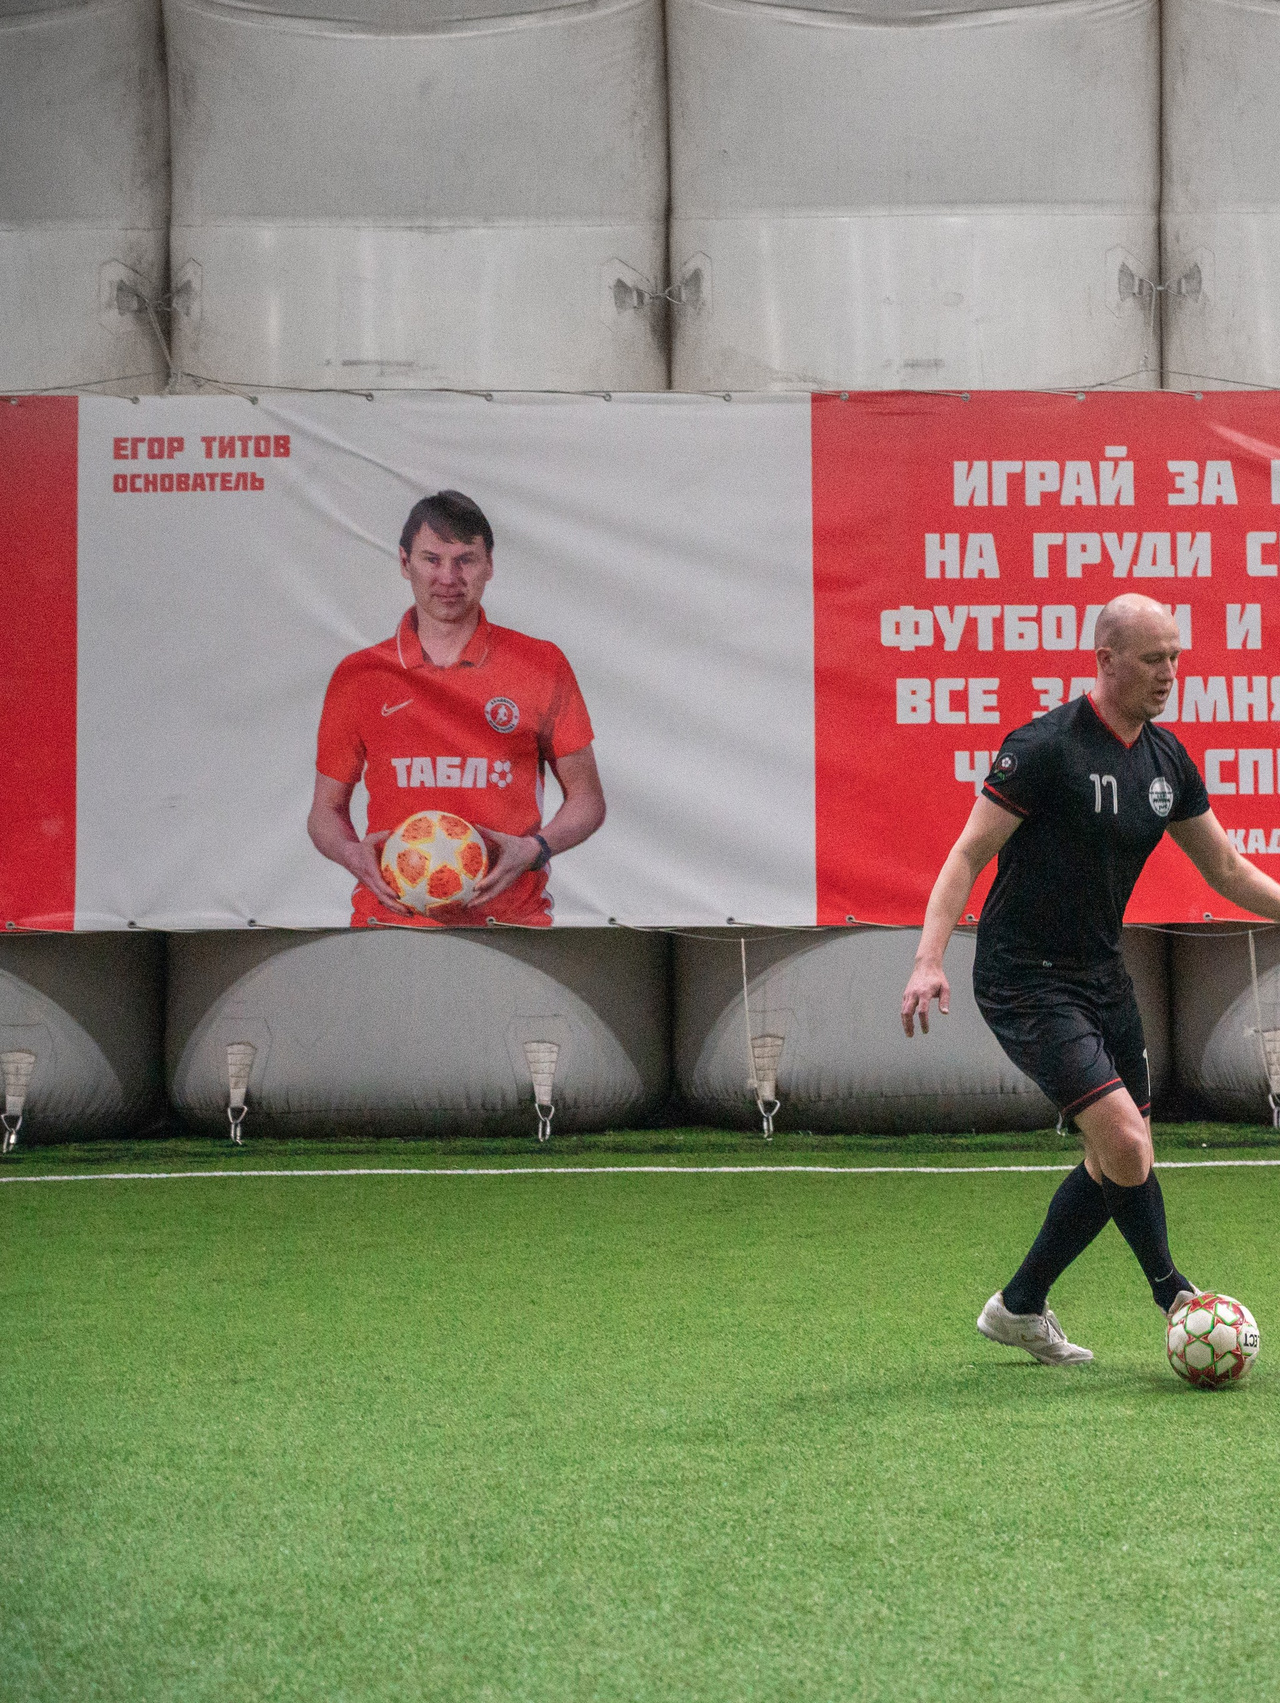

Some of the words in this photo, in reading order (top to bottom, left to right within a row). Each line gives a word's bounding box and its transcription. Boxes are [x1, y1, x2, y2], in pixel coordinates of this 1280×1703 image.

[113, 436, 184, 460] ЕГОР
[201, 435, 290, 458] ТИТОВ
[113, 471, 264, 493] ОСНОВАТЕЛЬ
[953, 445, 1135, 507] ИГРАЙ
[1168, 459, 1238, 506] ЗА
[924, 532, 1000, 579] НА
[1032, 530, 1212, 579] ГРУДИ
[1225, 603, 1262, 650] И
[895, 677, 1001, 725] ВСЕ
